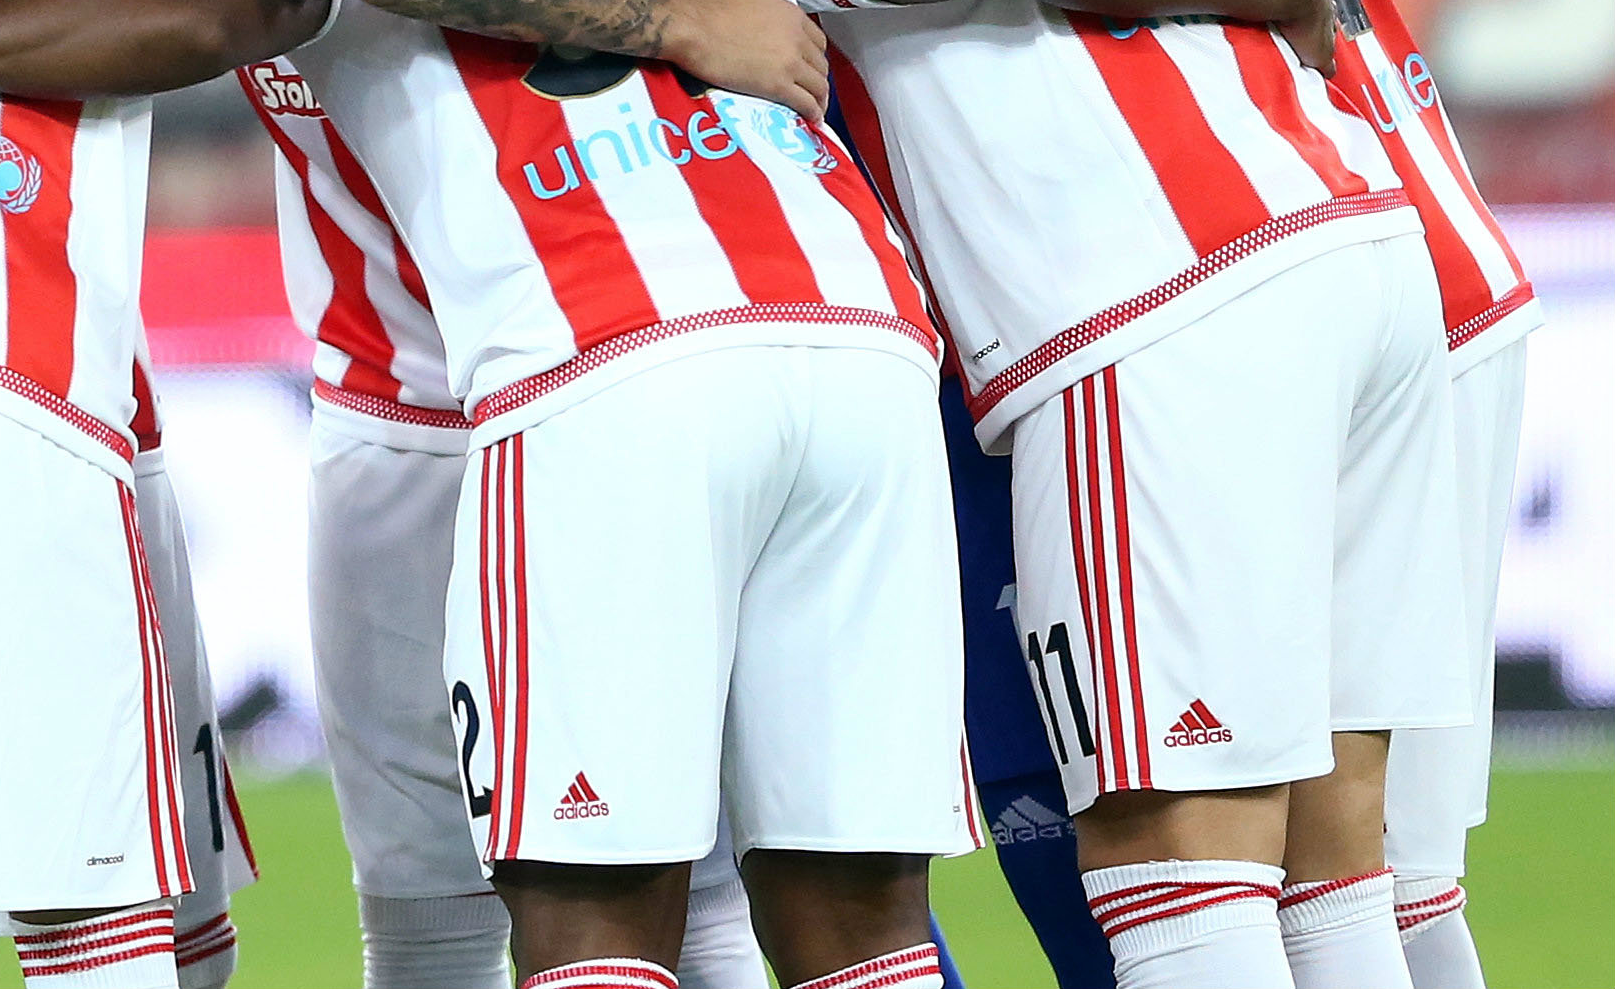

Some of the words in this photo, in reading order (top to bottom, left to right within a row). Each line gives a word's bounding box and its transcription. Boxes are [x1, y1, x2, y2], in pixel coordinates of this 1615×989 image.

[523, 97, 754, 201] unicef
[1164, 726, 1234, 748] adidas
[553, 800, 610, 821] adidas
